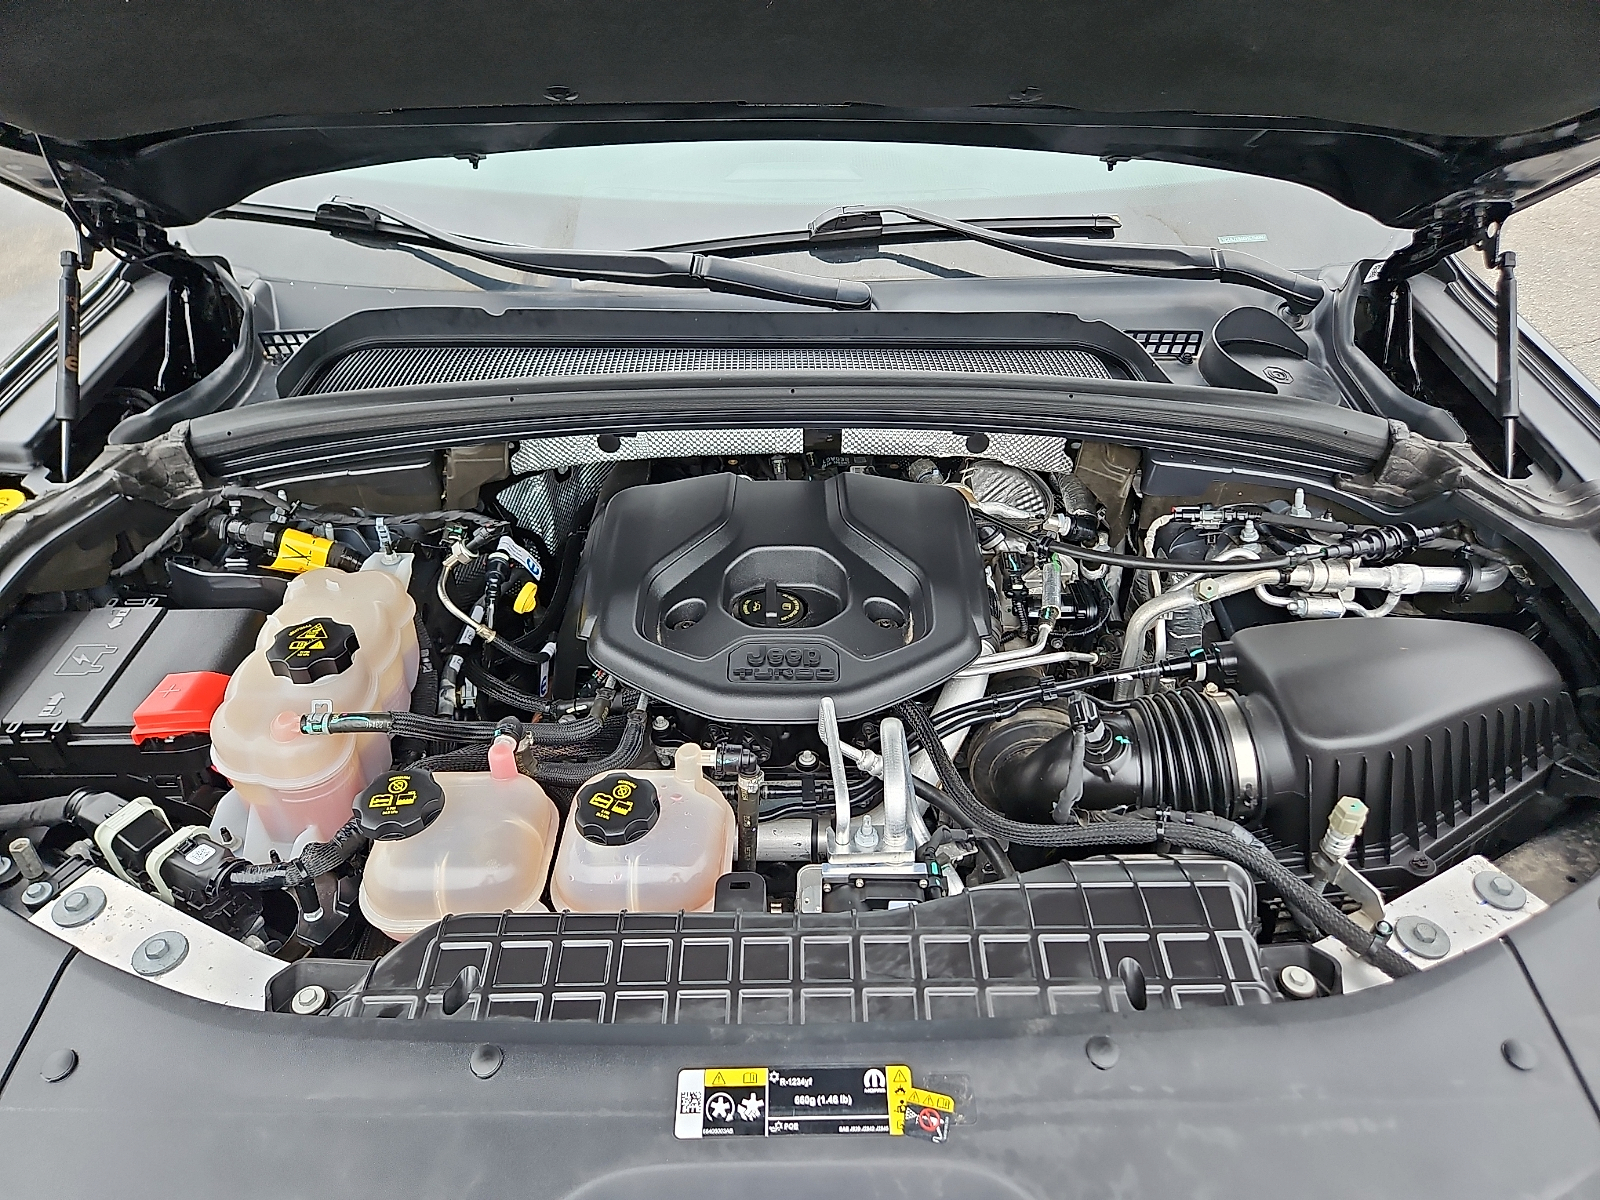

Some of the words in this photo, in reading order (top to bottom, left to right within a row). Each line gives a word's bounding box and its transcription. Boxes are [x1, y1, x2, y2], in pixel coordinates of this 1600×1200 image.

[746, 645, 822, 668] Jeep
[732, 668, 835, 681] TURBO
[779, 1077, 813, 1088] R-1234yf
[839, 1094, 853, 1106] lb)
